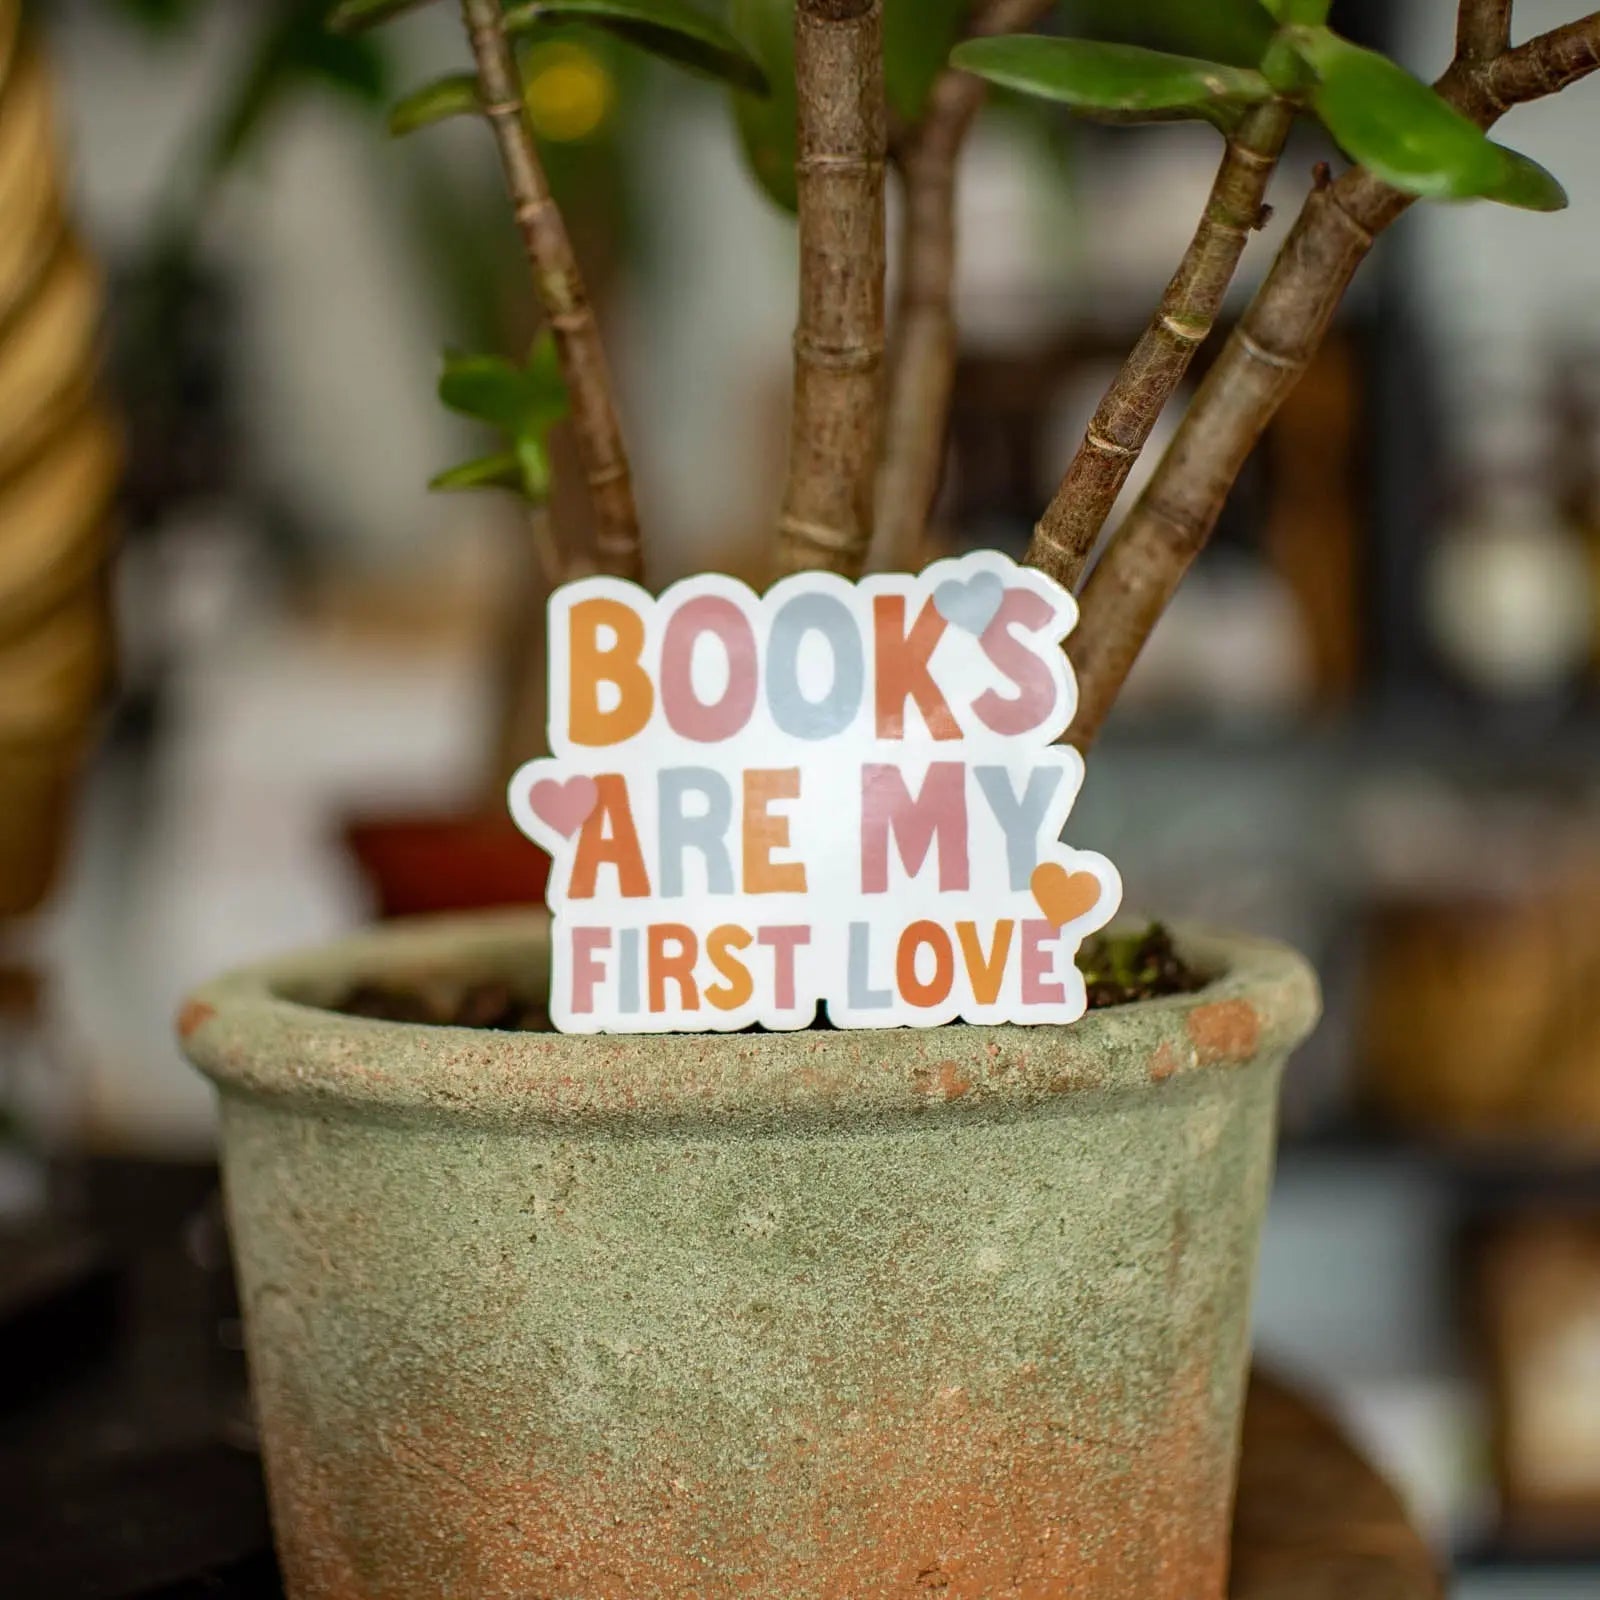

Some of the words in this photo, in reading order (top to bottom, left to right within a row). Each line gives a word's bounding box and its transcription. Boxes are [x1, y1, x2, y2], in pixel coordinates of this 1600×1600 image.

[568, 587, 1058, 747] BOOKS
[567, 767, 807, 899] ARE
[861, 761, 1064, 894] MY
[571, 923, 811, 1013] FIRST
[847, 919, 1066, 1009] LOVE
